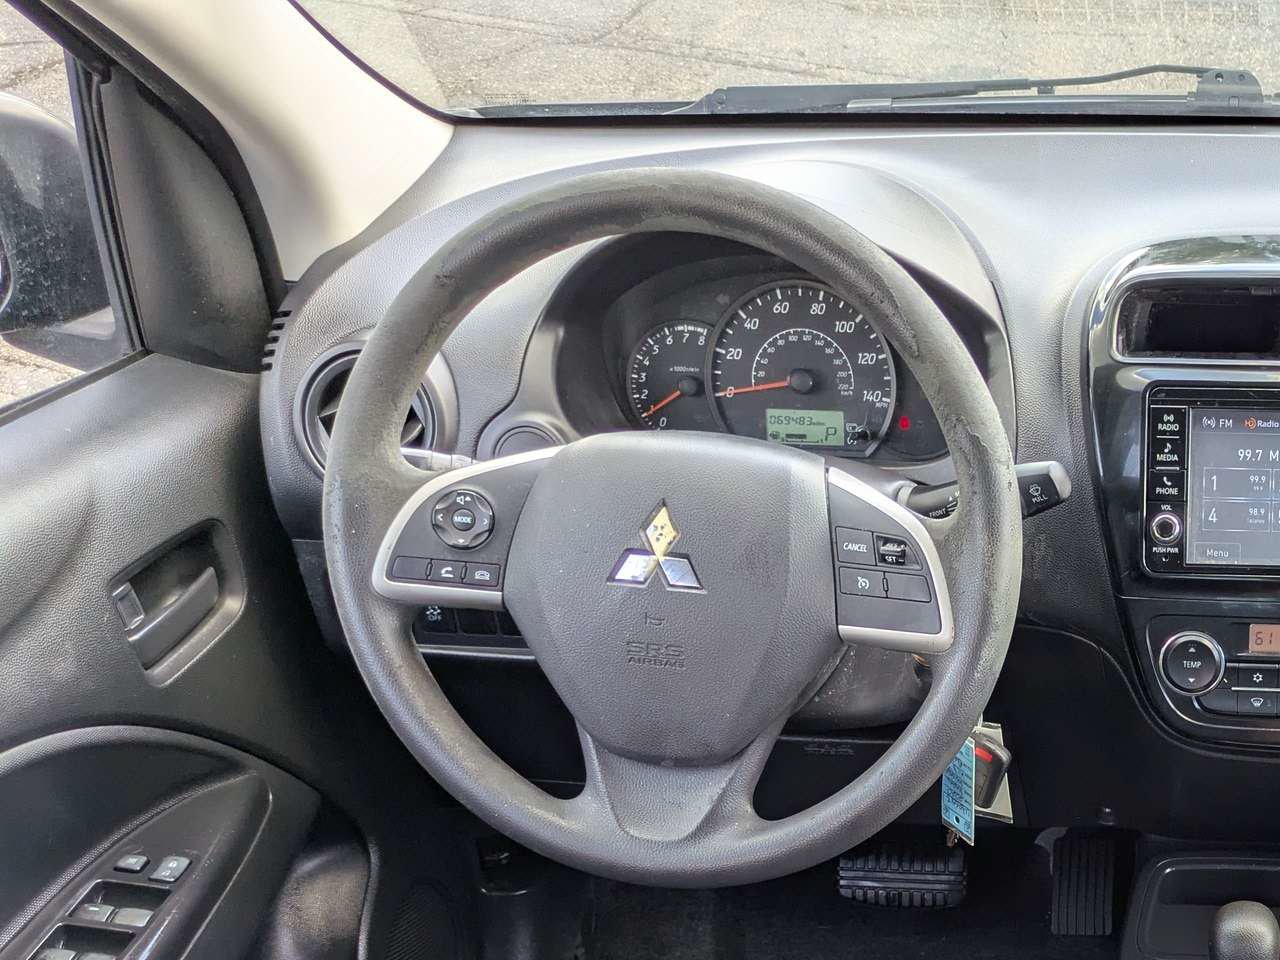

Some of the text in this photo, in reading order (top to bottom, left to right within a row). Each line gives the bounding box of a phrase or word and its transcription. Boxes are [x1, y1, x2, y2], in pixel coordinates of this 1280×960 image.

[773, 302, 790, 314] 60
[810, 303, 826, 315] 80
[744, 318, 760, 330] 40
[835, 321, 855, 333] 100
[666, 335, 673, 345] 6
[682, 333, 690, 343] 7
[698, 335, 706, 346] 8
[652, 345, 660, 355] 5
[726, 348, 743, 360] 20
[643, 356, 650, 367] 4
[858, 353, 876, 365] 120
[638, 372, 647, 382] 3
[641, 389, 649, 399] 2
[726, 386, 735, 398] 0
[863, 390, 882, 402] 140
[659, 417, 667, 427] 0
[1219, 419, 1233, 428] FM
[1257, 420, 1280, 428] Radio
[825, 427, 837, 441] P
[1238, 449, 1262, 461] 99.7
[1210, 475, 1217, 491] 1
[1249, 475, 1266, 483] 99.9
[1156, 487, 1178, 495] PHONE
[928, 508, 946, 518] FRONT
[1208, 507, 1218, 523] 4
[453, 516, 473, 524] MODE
[843, 542, 867, 552] CANCEL
[1206, 548, 1229, 557] Menu
[1255, 632, 1274, 646] 61
[1183, 660, 1202, 669] TEMP
